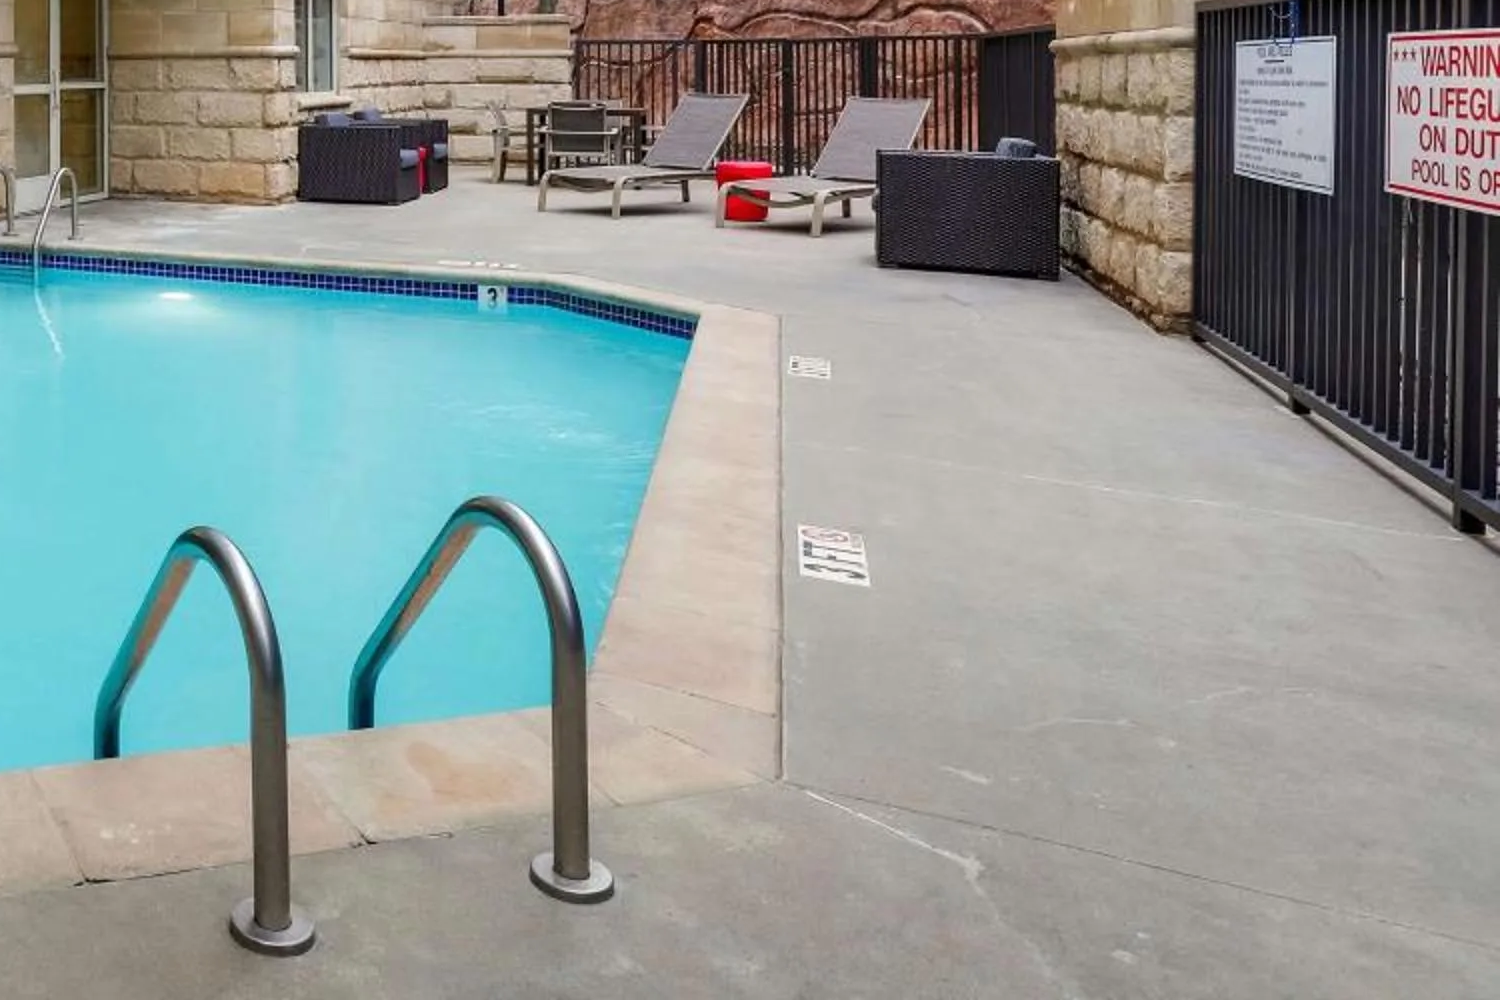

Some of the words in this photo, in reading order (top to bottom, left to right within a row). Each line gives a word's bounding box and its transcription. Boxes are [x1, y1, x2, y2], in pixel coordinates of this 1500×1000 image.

[1397, 85, 1421, 116] NO
[1419, 123, 1446, 153] ON
[1455, 127, 1500, 160] DUT
[1411, 159, 1448, 187] POOL
[1455, 165, 1470, 191] IS
